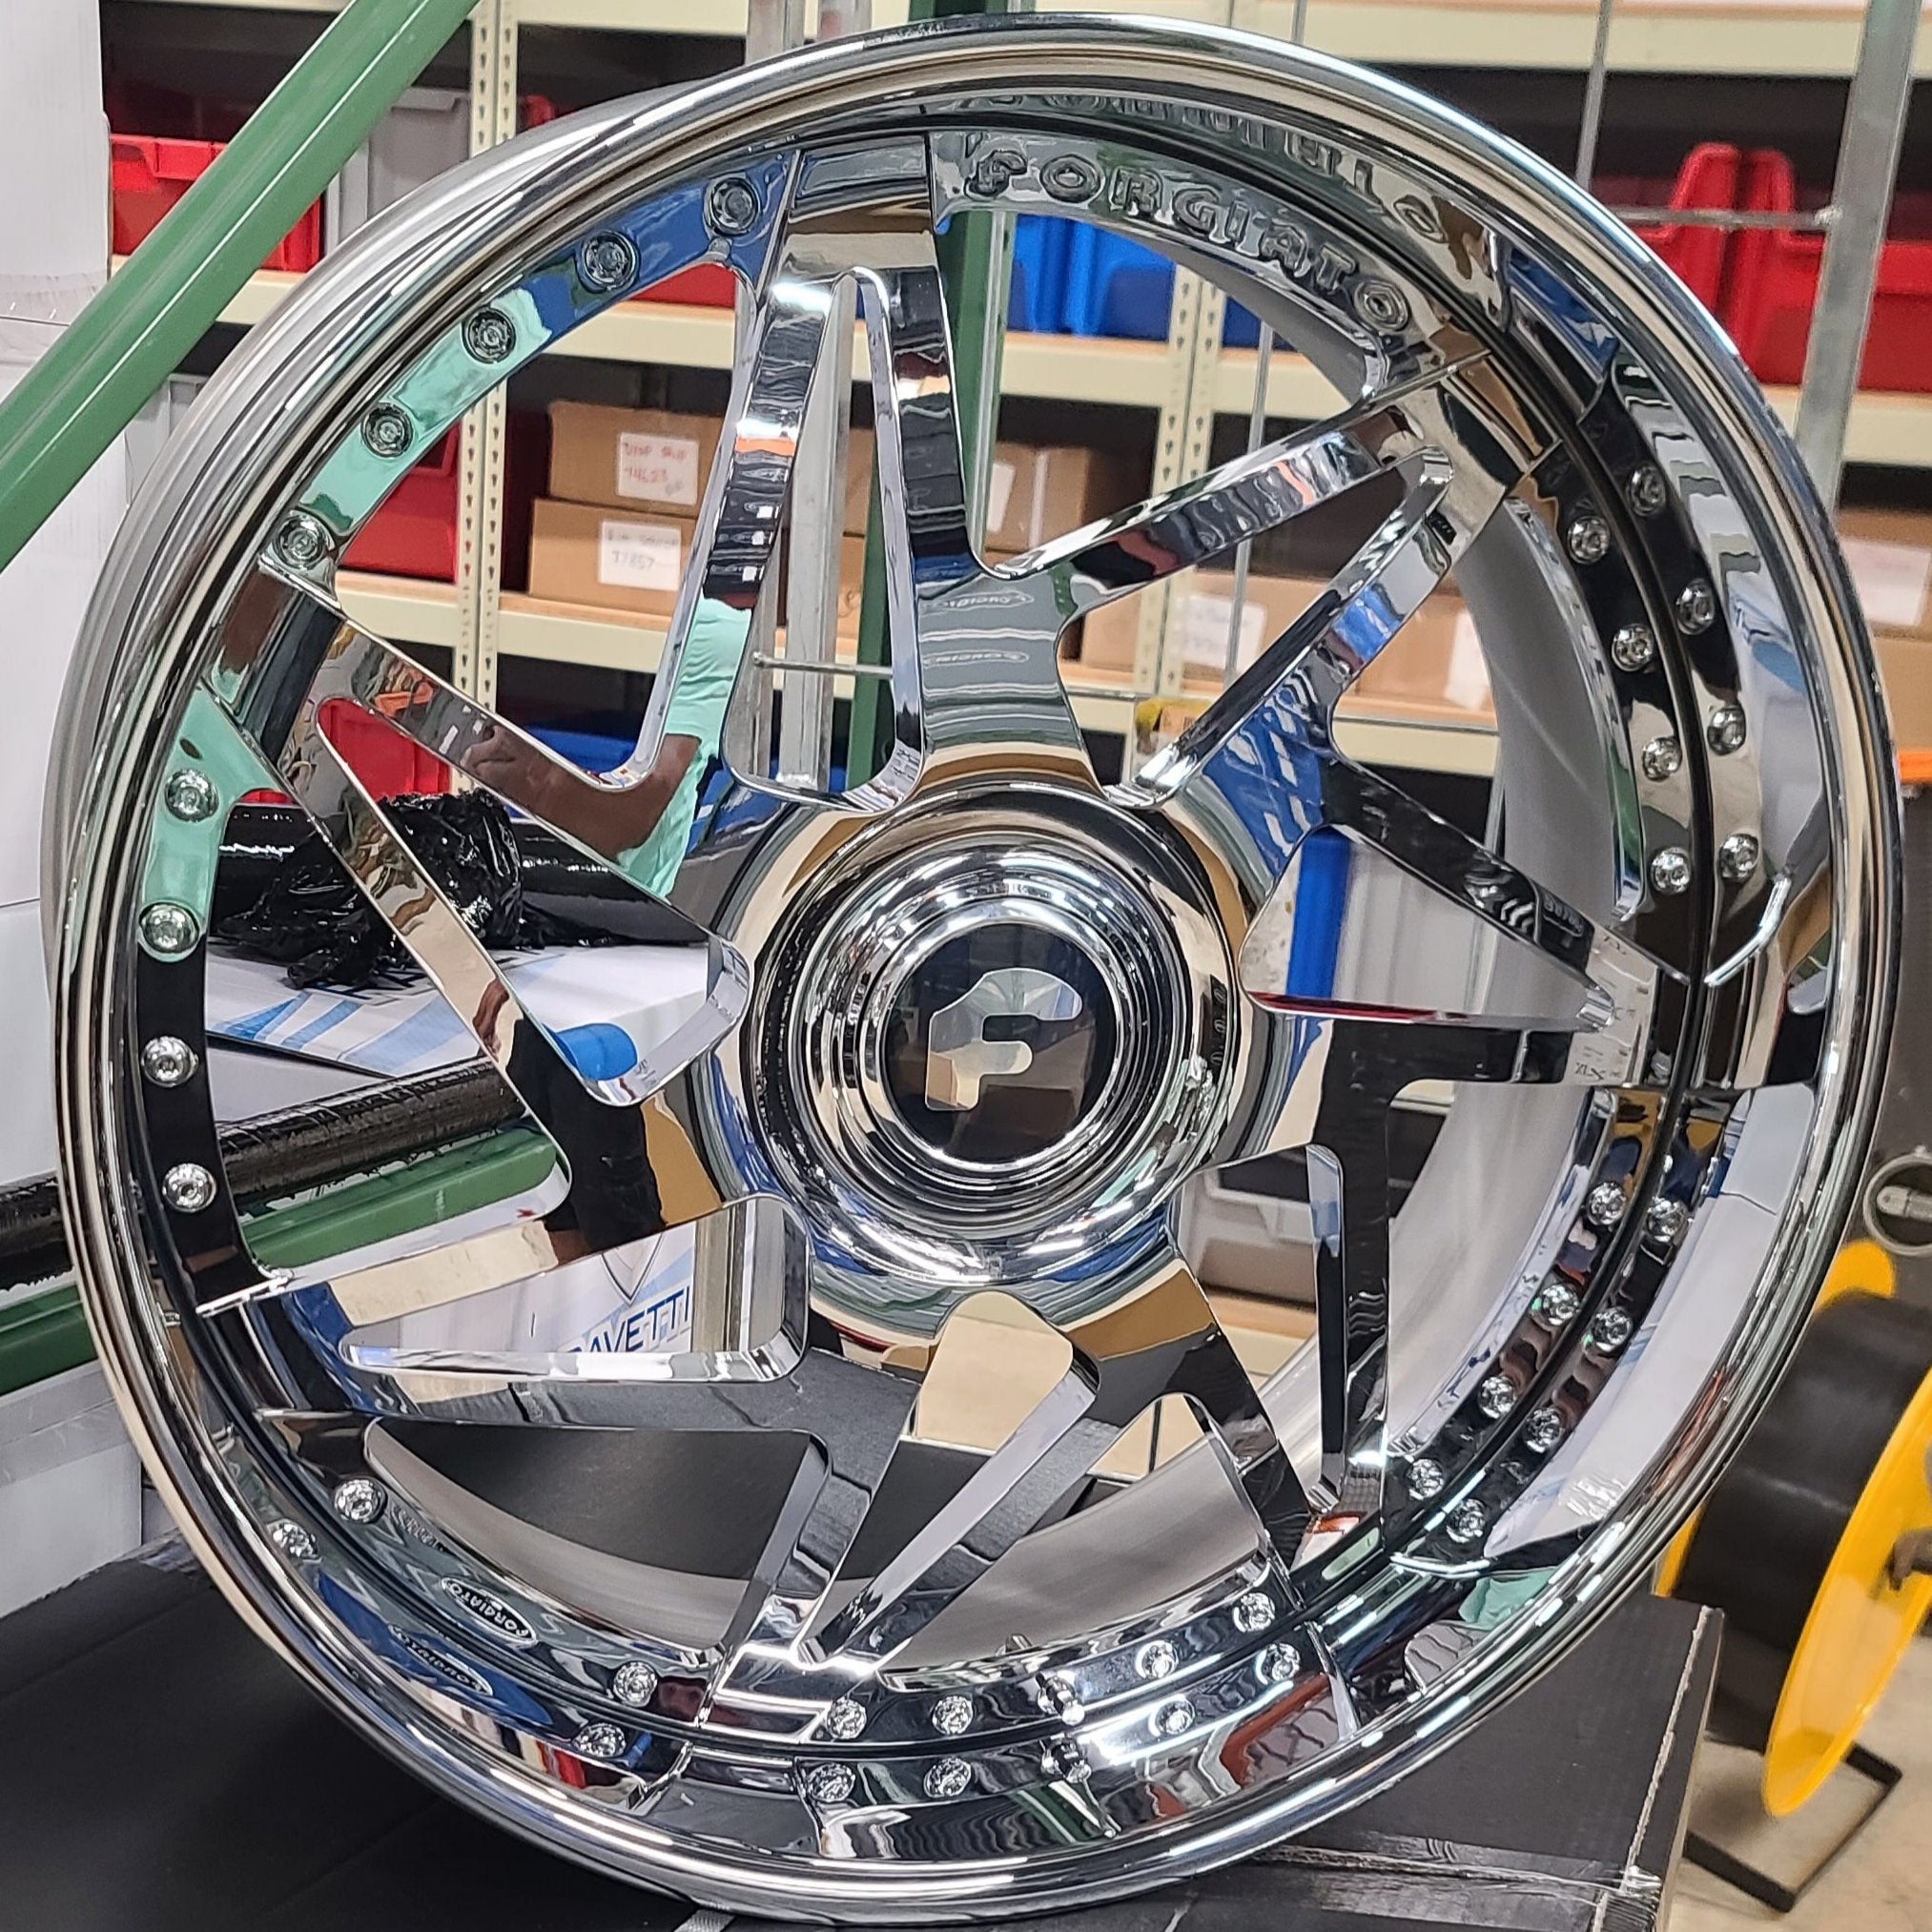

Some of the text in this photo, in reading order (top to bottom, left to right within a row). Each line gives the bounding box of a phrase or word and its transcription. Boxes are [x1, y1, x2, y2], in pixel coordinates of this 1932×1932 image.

[963, 148, 1412, 332] FORGIATO
[566, 1285, 690, 1352] VETTI
[448, 1582, 529, 1637] FORGIATO
